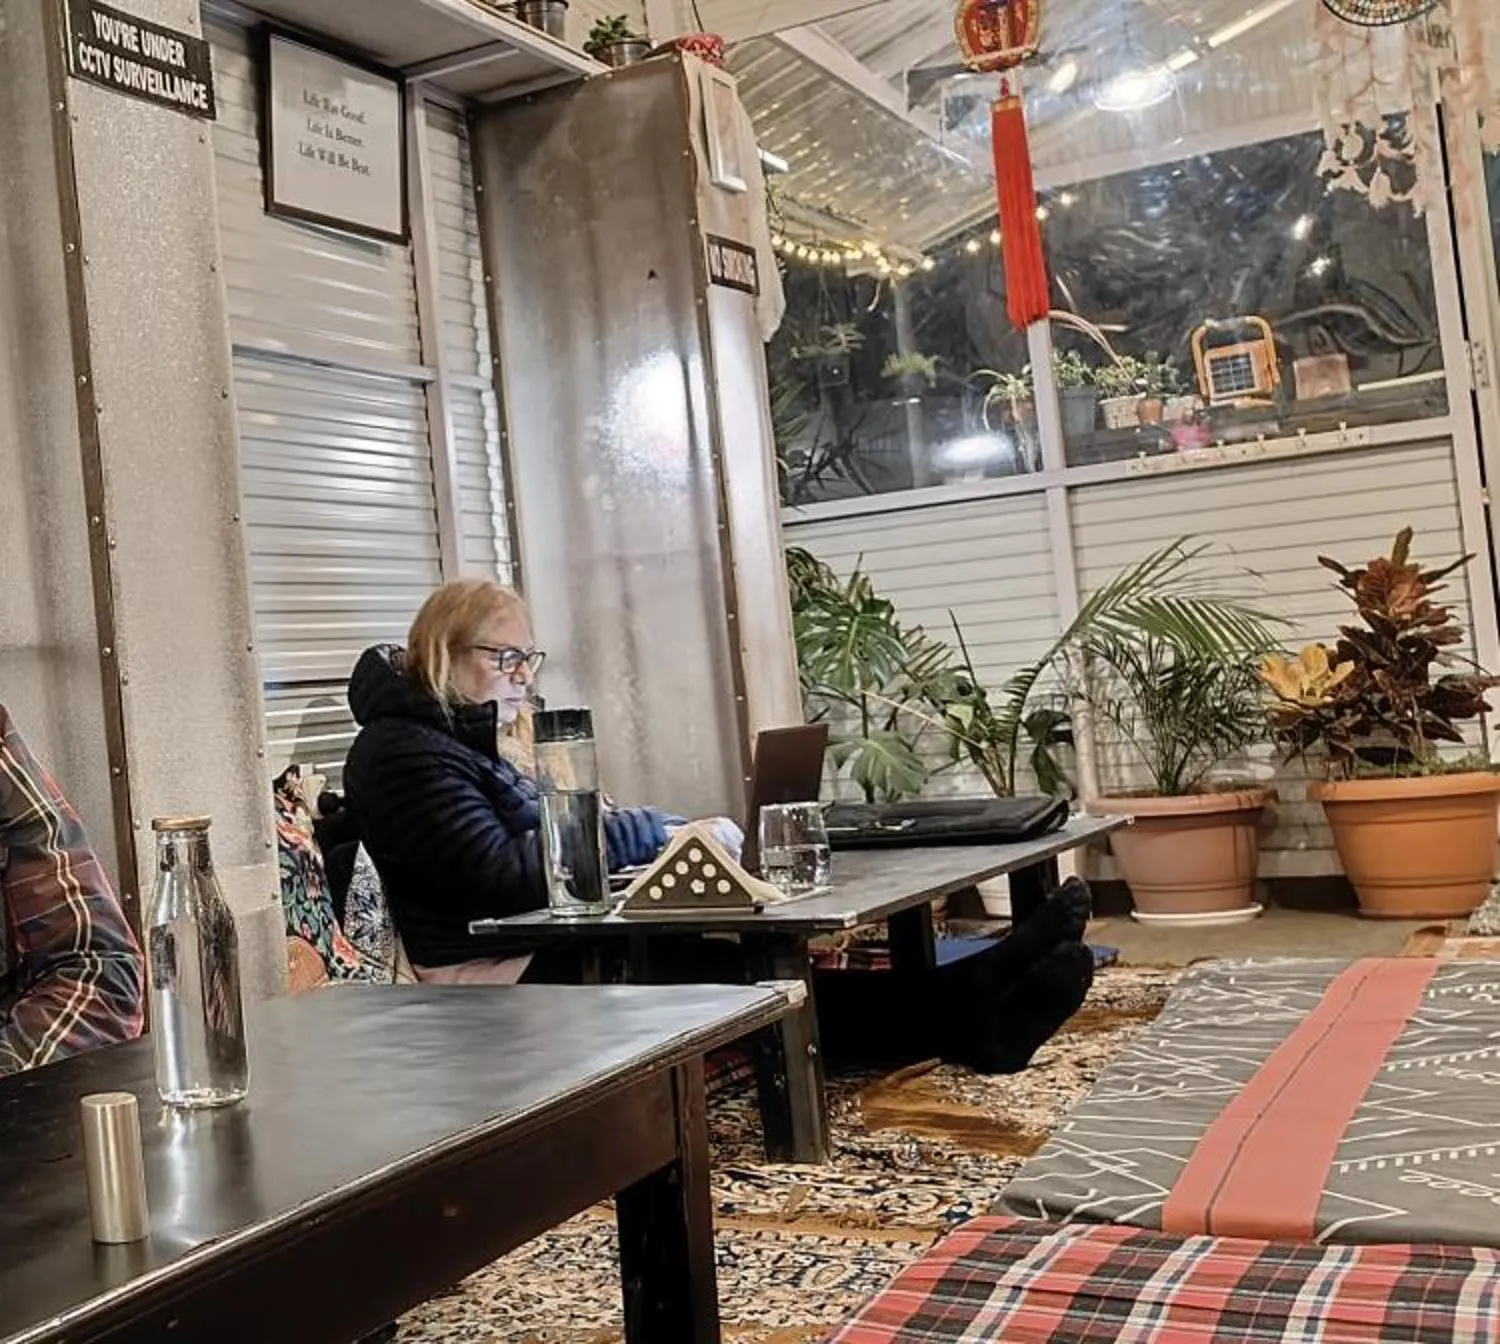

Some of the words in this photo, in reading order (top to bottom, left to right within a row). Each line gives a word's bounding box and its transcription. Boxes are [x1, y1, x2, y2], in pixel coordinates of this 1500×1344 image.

[91, 10, 139, 52] YOU'RE
[141, 29, 186, 68] UNDER
[79, 41, 110, 79] CCTV
[113, 55, 209, 109] SURVEILLANCE
